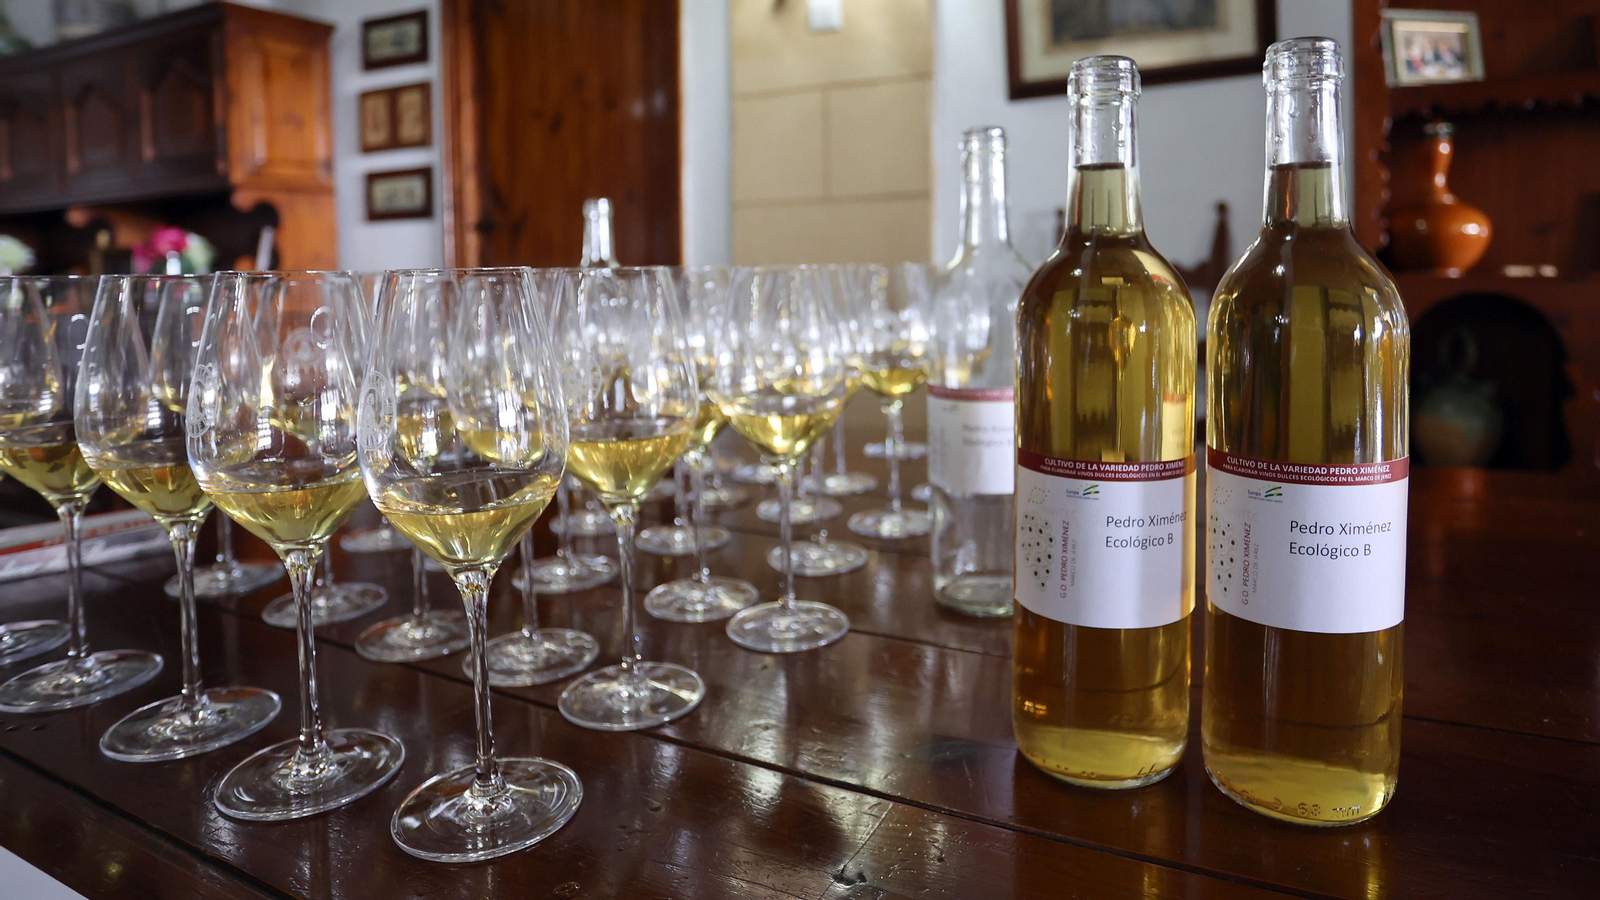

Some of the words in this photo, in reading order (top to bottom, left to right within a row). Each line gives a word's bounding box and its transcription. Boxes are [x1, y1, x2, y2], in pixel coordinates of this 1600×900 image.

[1044, 458, 1074, 469] CULTIVO
[1075, 462, 1086, 470] DE
[1088, 463, 1098, 471] LA
[1099, 464, 1140, 472] VARIEDAD
[1141, 463, 1164, 471] PEDRO
[1051, 467, 1076, 475] ELABORAR
[1226, 456, 1255, 468] CULTIVO
[1257, 462, 1268, 470] DE
[1282, 465, 1327, 474] VARIEDAD
[1330, 467, 1358, 475] PEDRO
[1360, 465, 1390, 474] XIMÉNEZ
[1233, 466, 1258, 475] ELABORAR
[1106, 515, 1145, 528] Pedro
[1148, 511, 1187, 527] Ximénez
[1290, 520, 1335, 535] Pedro
[1338, 520, 1392, 536] Ximénez
[1105, 535, 1165, 550] Ecológico
[1167, 532, 1174, 545] B
[1289, 542, 1359, 560] Ecológico
[1364, 543, 1372, 557] B
[1060, 555, 1068, 582] PEDRO
[1242, 560, 1250, 587] PEDRO
[1252, 562, 1258, 570] DE
